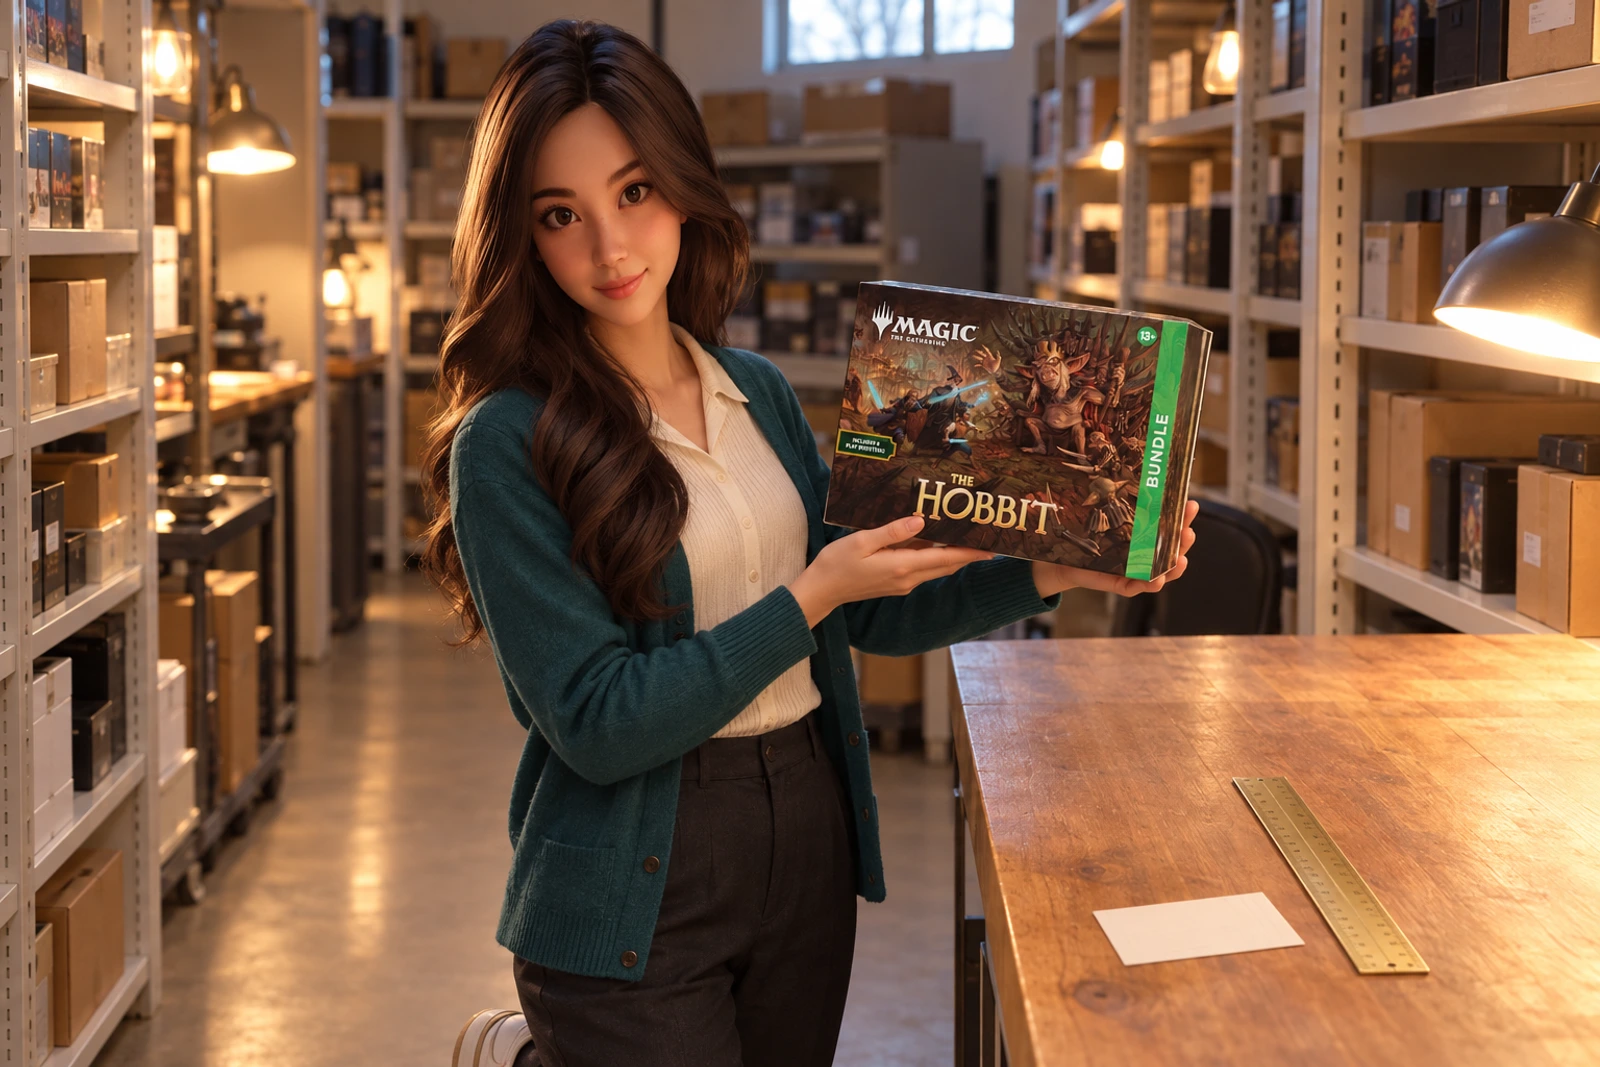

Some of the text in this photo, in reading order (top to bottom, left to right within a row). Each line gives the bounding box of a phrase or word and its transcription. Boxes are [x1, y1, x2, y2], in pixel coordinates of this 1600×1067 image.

[891, 316, 977, 342] MAGIC
[1140, 331, 1156, 341] 13+
[1146, 414, 1169, 488] BUNDLE
[950, 473, 975, 487] THE
[912, 478, 1058, 535] HOBBIT
